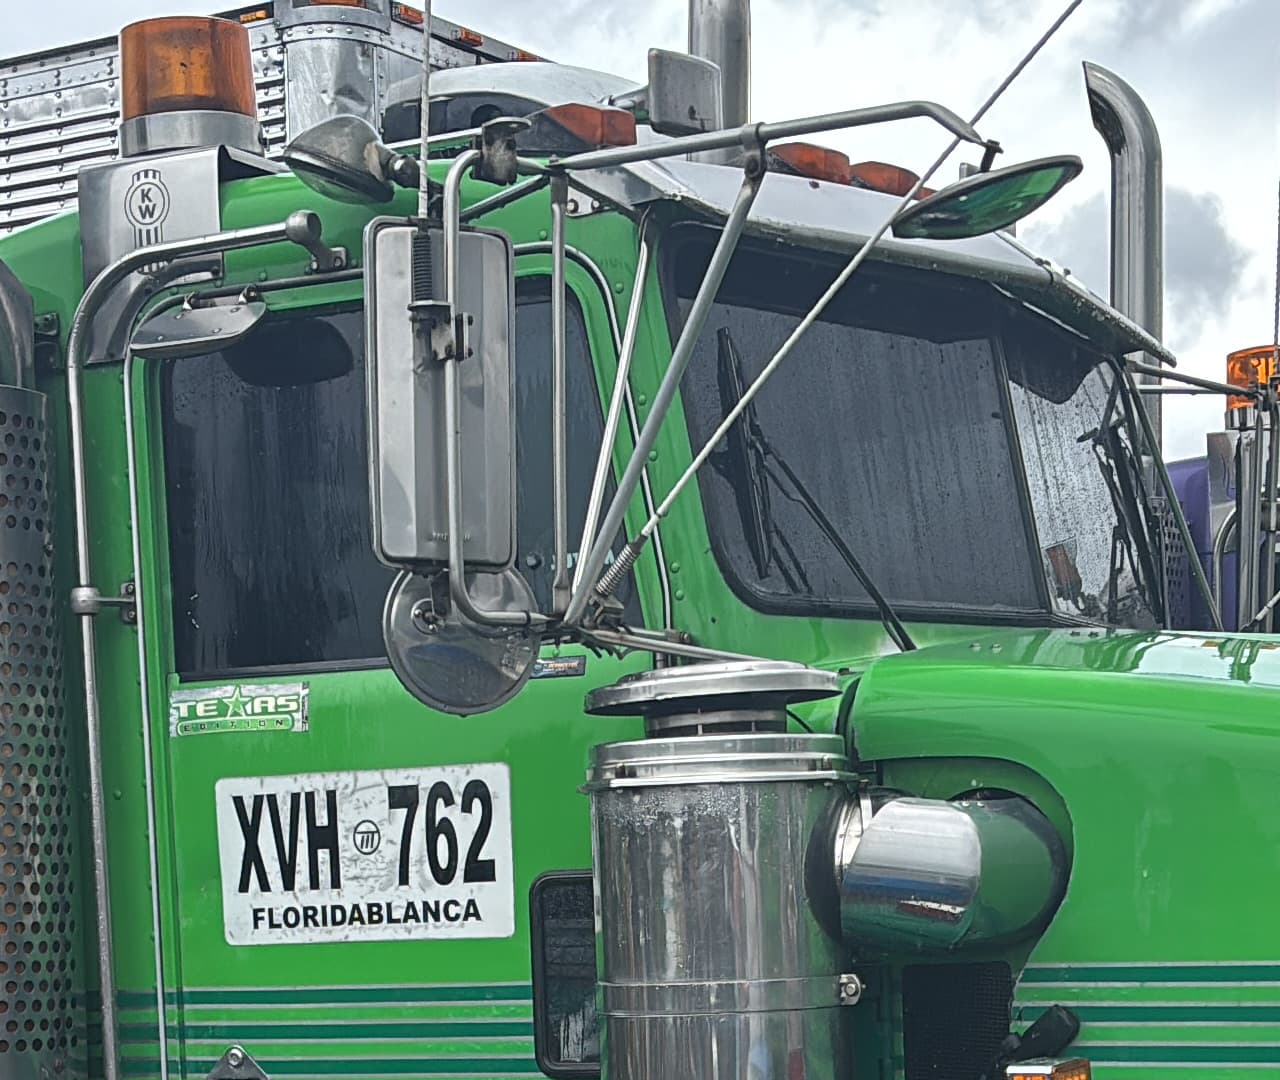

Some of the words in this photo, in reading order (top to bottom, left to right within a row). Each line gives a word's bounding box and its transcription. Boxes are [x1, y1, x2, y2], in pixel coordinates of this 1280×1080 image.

[183, 719, 284, 732] EDITION
[232, 788, 342, 894] XVH
[387, 779, 497, 887] 762
[252, 898, 483, 931] FLORIDABLANCA
